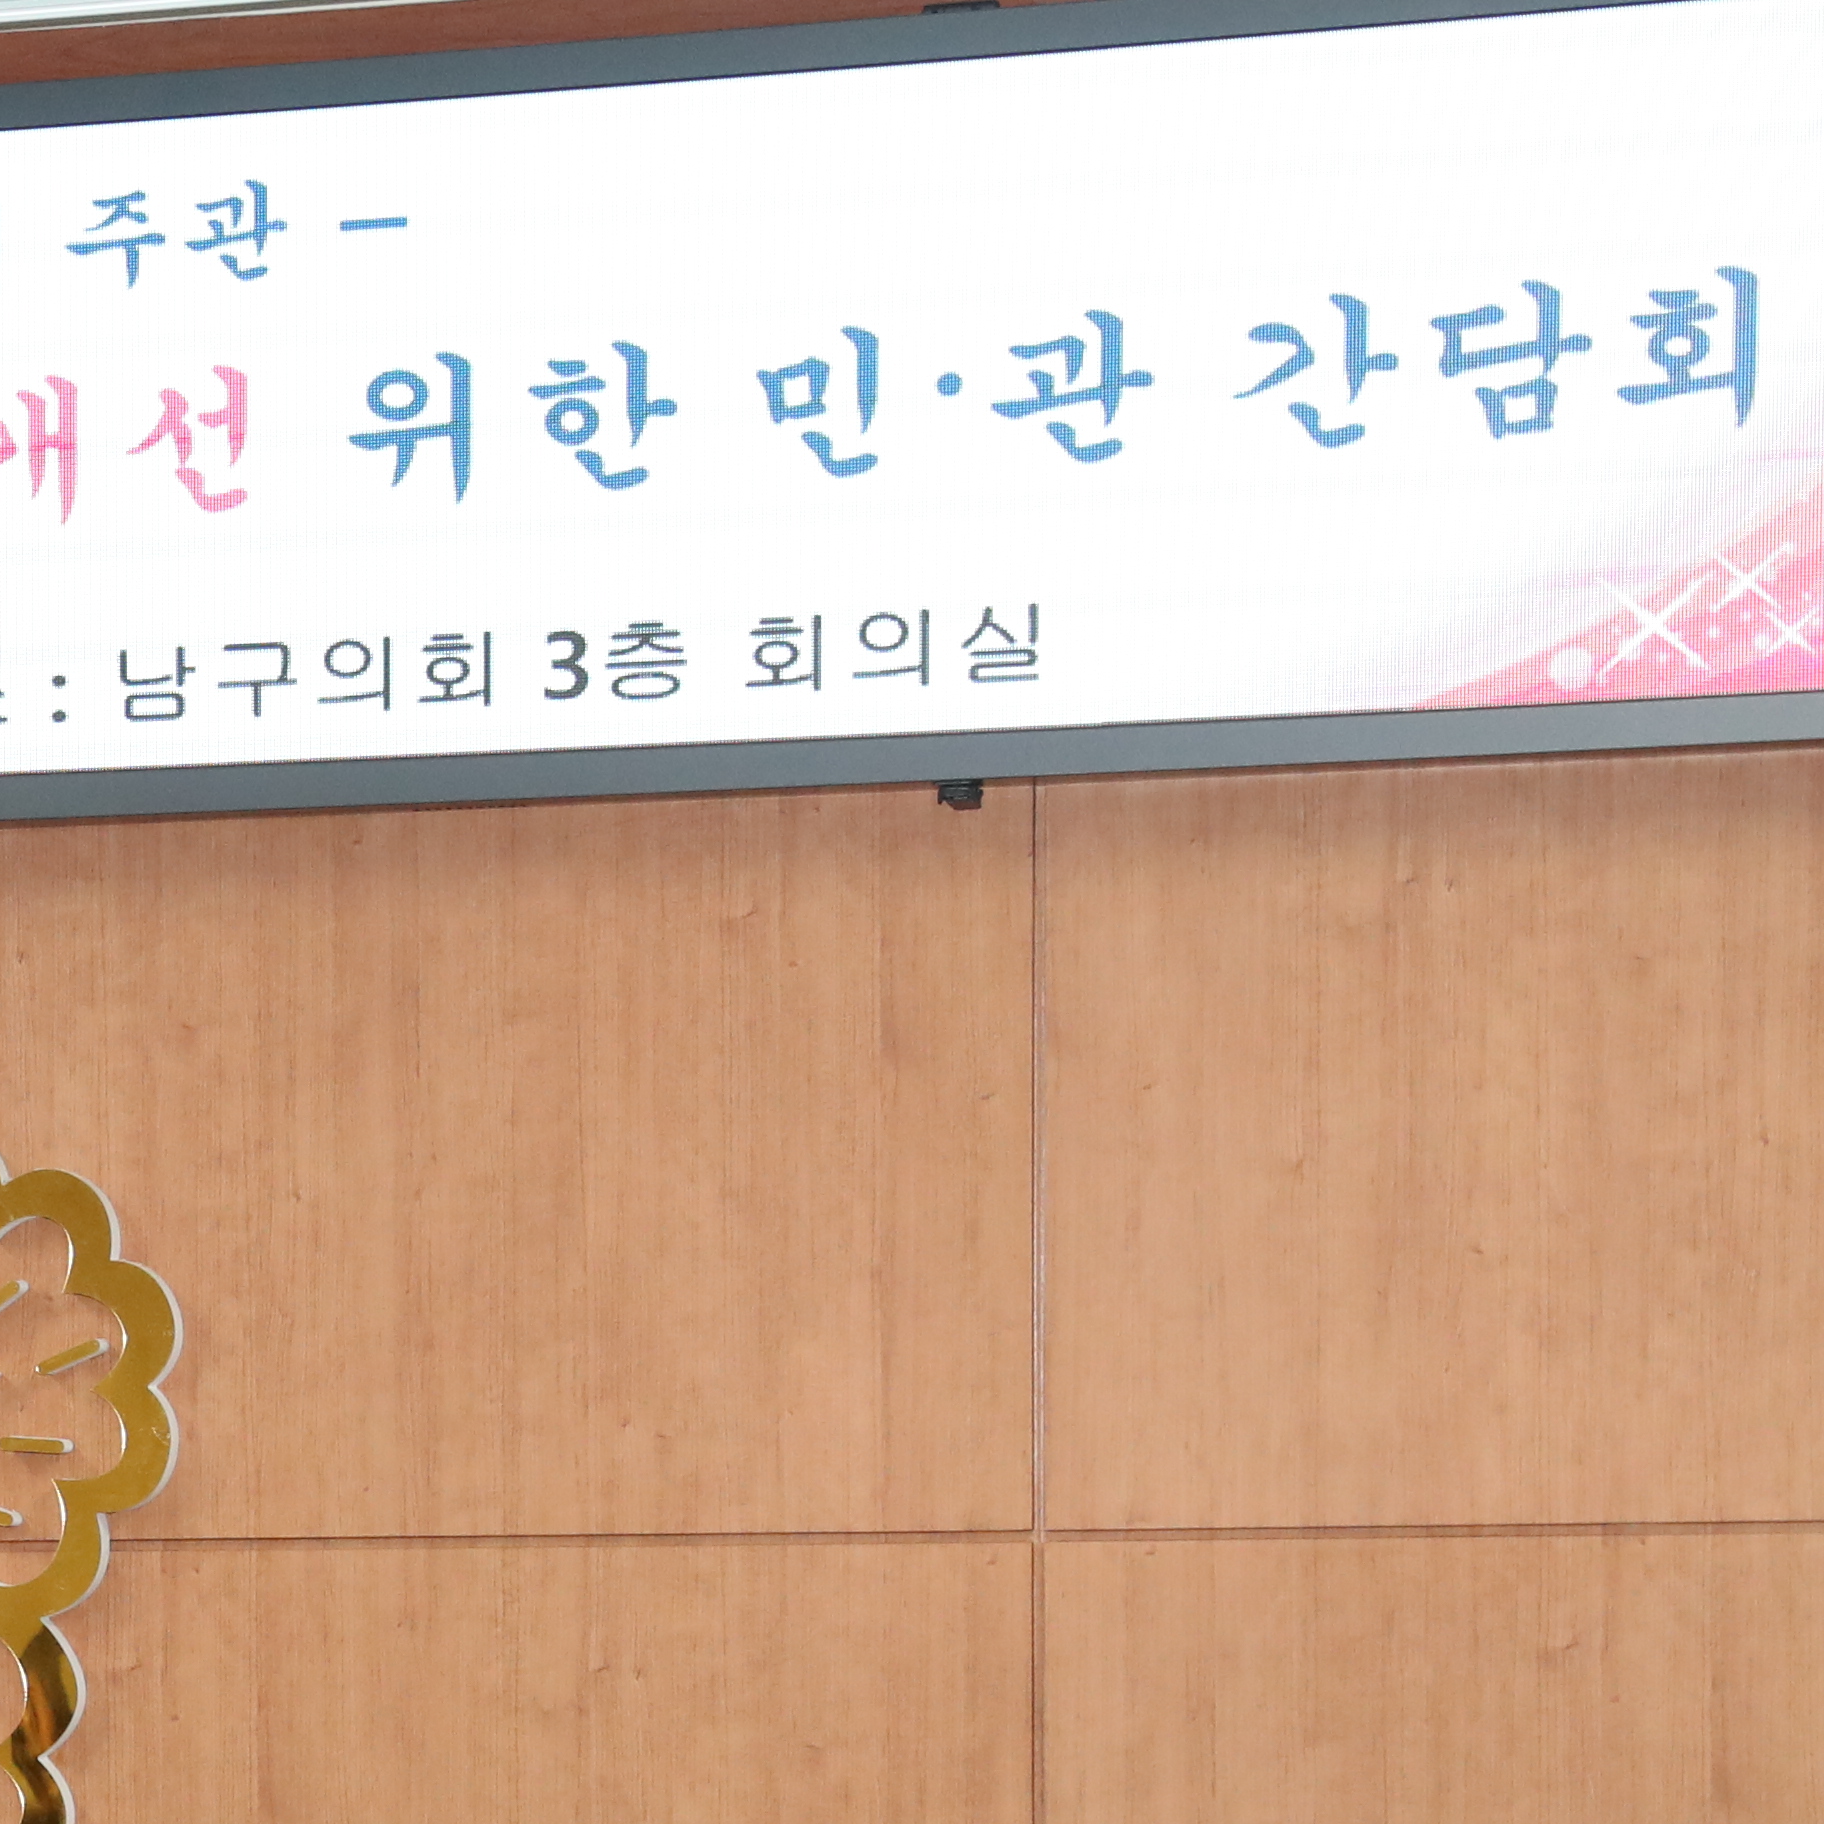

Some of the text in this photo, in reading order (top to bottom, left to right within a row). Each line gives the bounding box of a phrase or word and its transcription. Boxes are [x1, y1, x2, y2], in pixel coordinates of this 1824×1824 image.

[65, 180, 288, 288] 주관
[348, 341, 678, 502] 위한
[1234, 267, 1758, 449] 간담회
[120, 631, 492, 722] 남구의회
[543, 622, 688, 700] 3층
[745, 603, 1039, 691] 회의실
